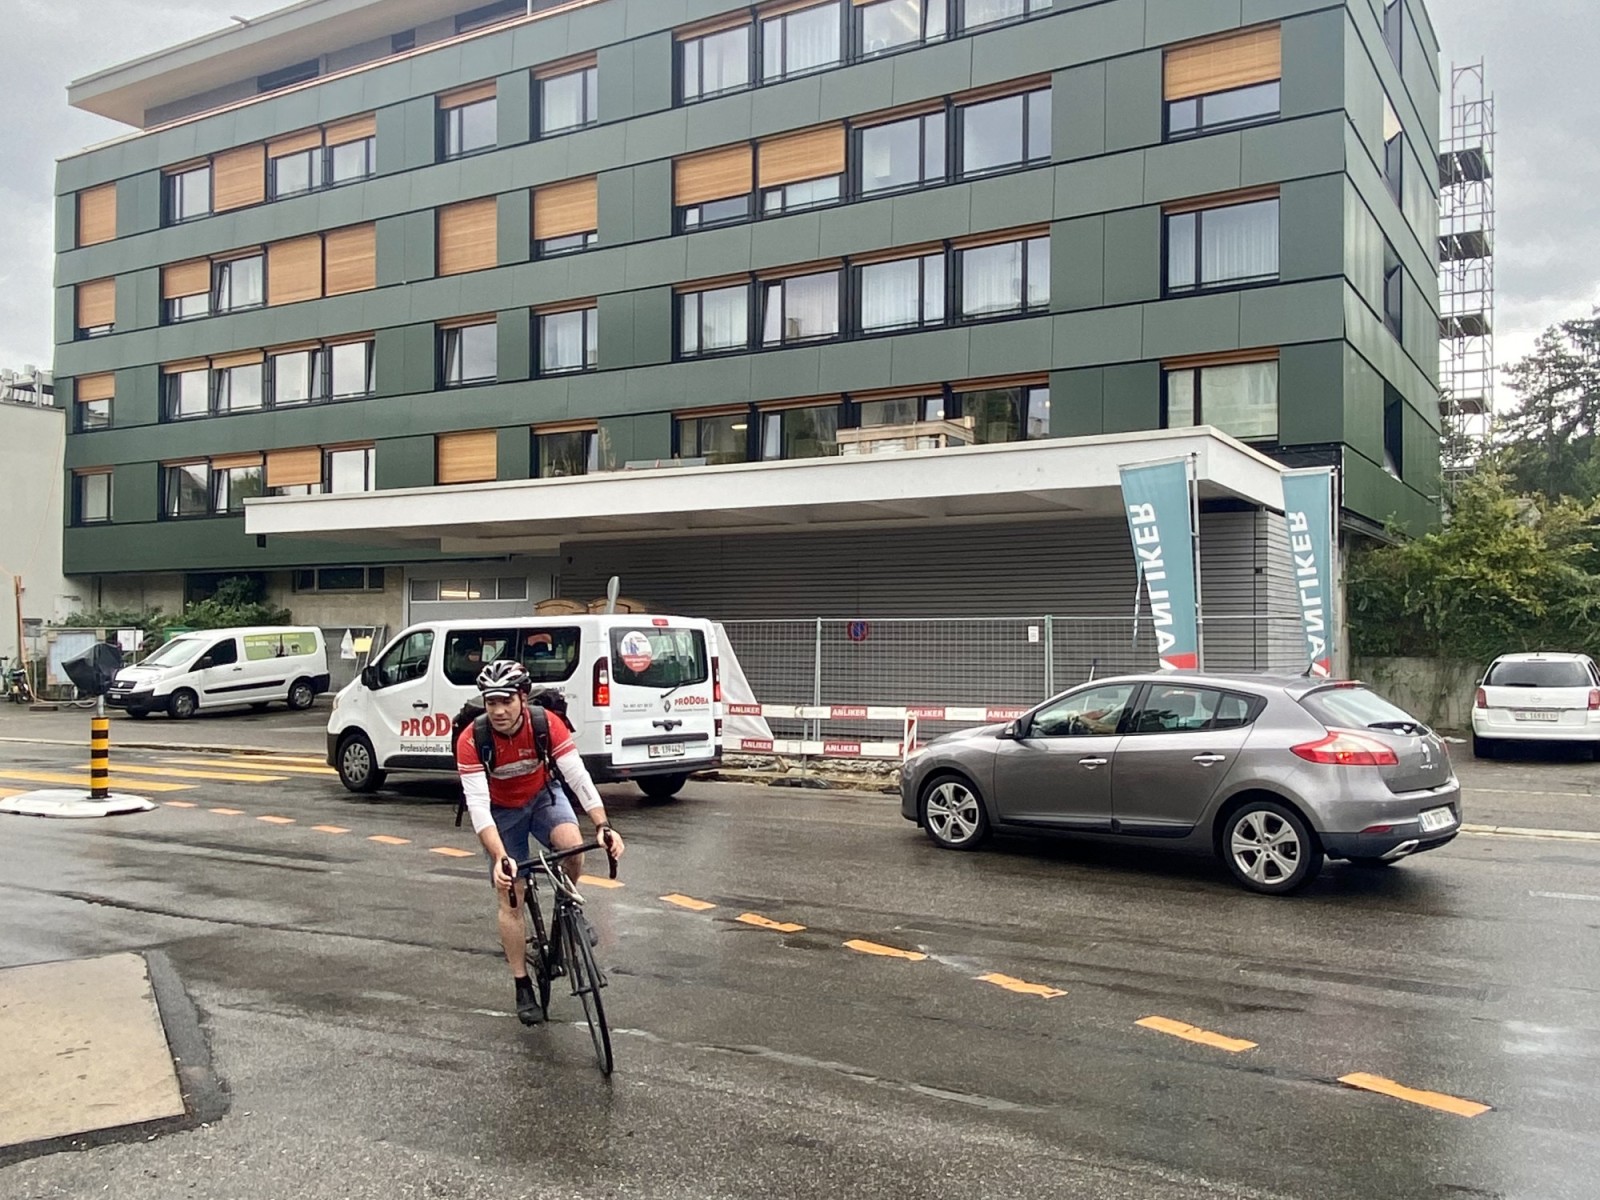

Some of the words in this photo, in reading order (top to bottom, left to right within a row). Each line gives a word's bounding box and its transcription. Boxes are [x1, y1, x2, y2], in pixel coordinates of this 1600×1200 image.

[674, 695, 709, 706] PRODOBA
[730, 706, 761, 714] ANLIKER
[832, 707, 866, 717] ANLIKER
[400, 713, 451, 736] PROD
[742, 741, 772, 750] ANLIKER
[825, 744, 860, 753] ANLIKER
